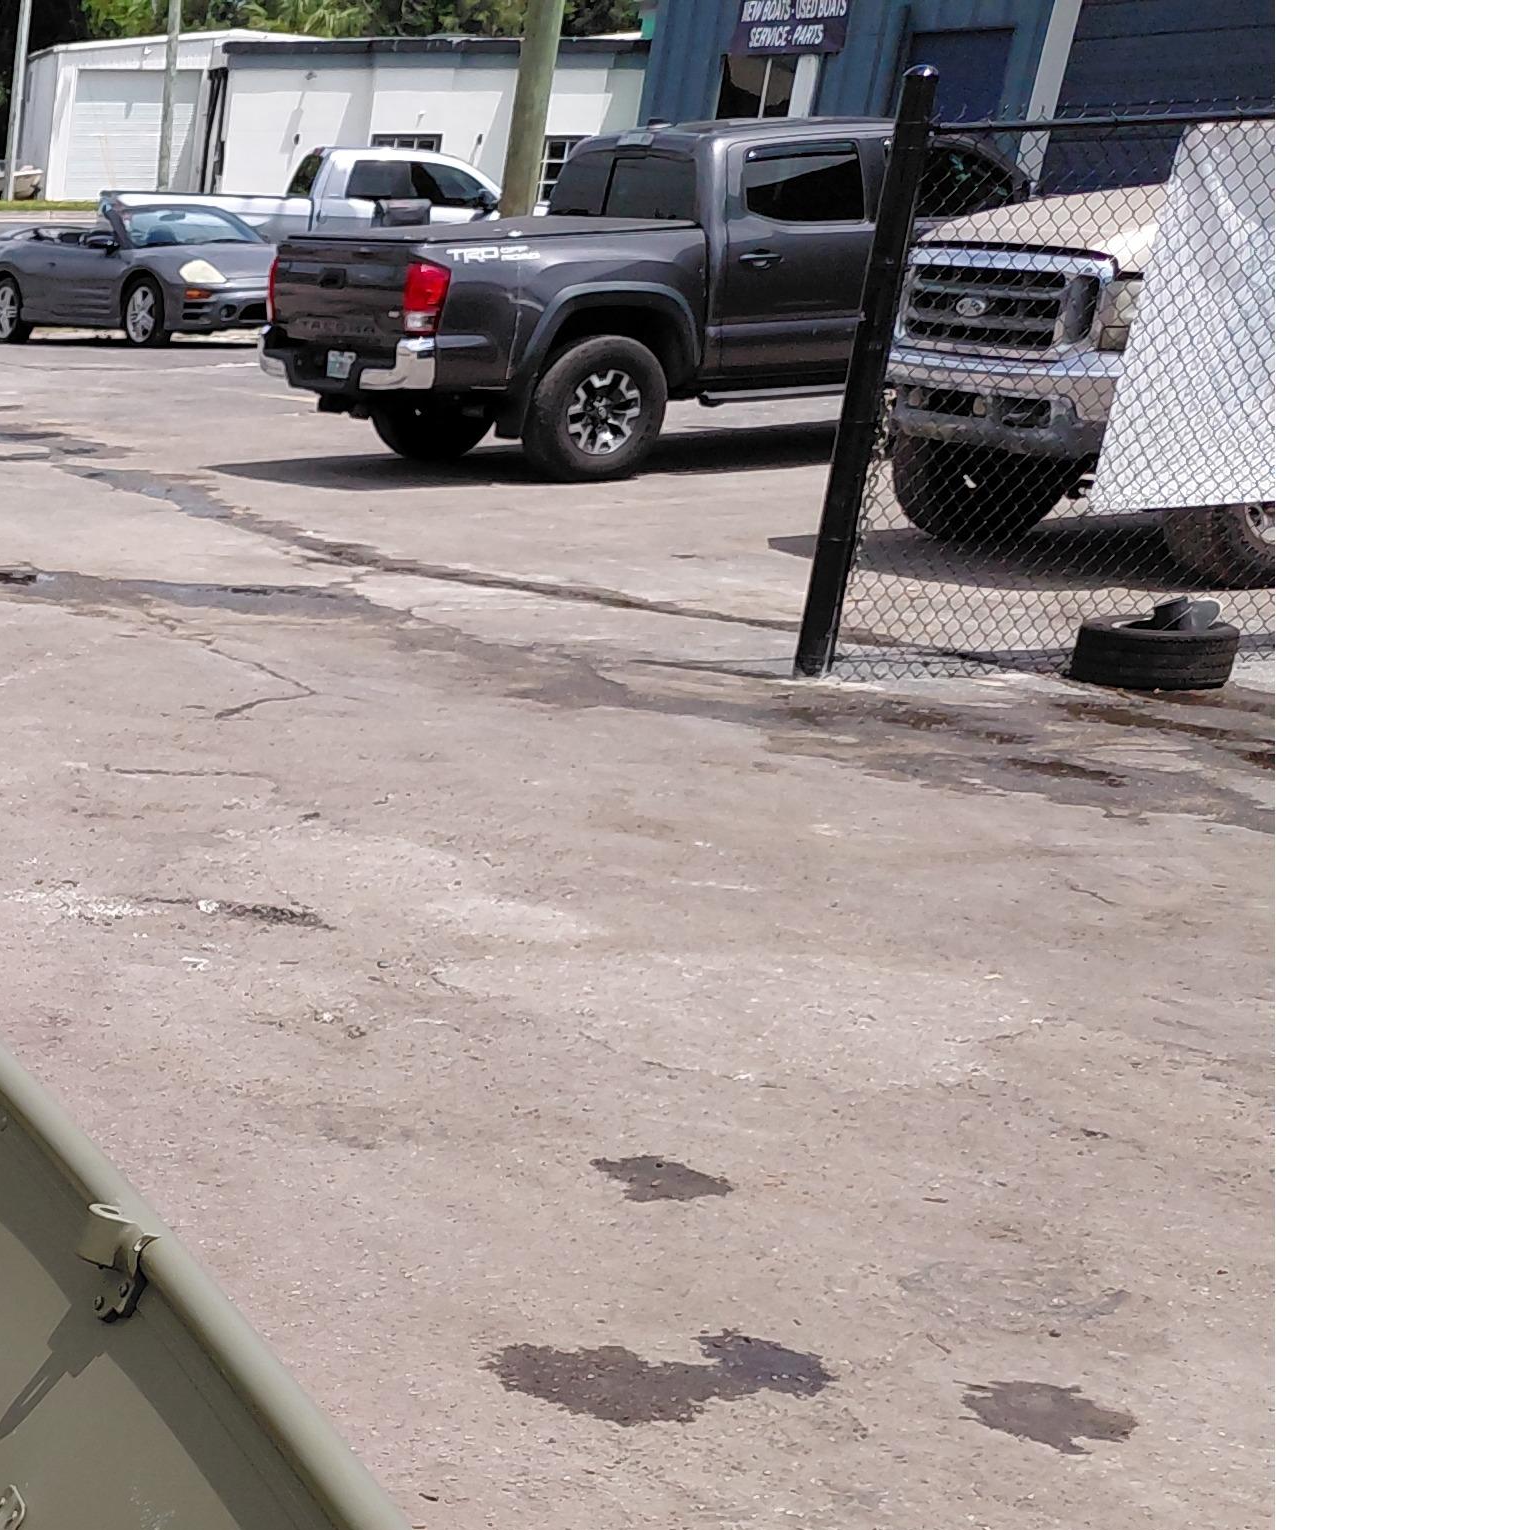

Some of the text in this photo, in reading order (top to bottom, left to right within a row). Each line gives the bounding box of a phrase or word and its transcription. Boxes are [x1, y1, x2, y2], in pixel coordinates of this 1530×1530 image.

[761, 0, 791, 21] BOATS
[795, 0, 820, 19] USED
[817, 0, 847, 18] BOATS
[749, 24, 824, 48] SERVICE PARTS
[446, 247, 499, 263] TRD
